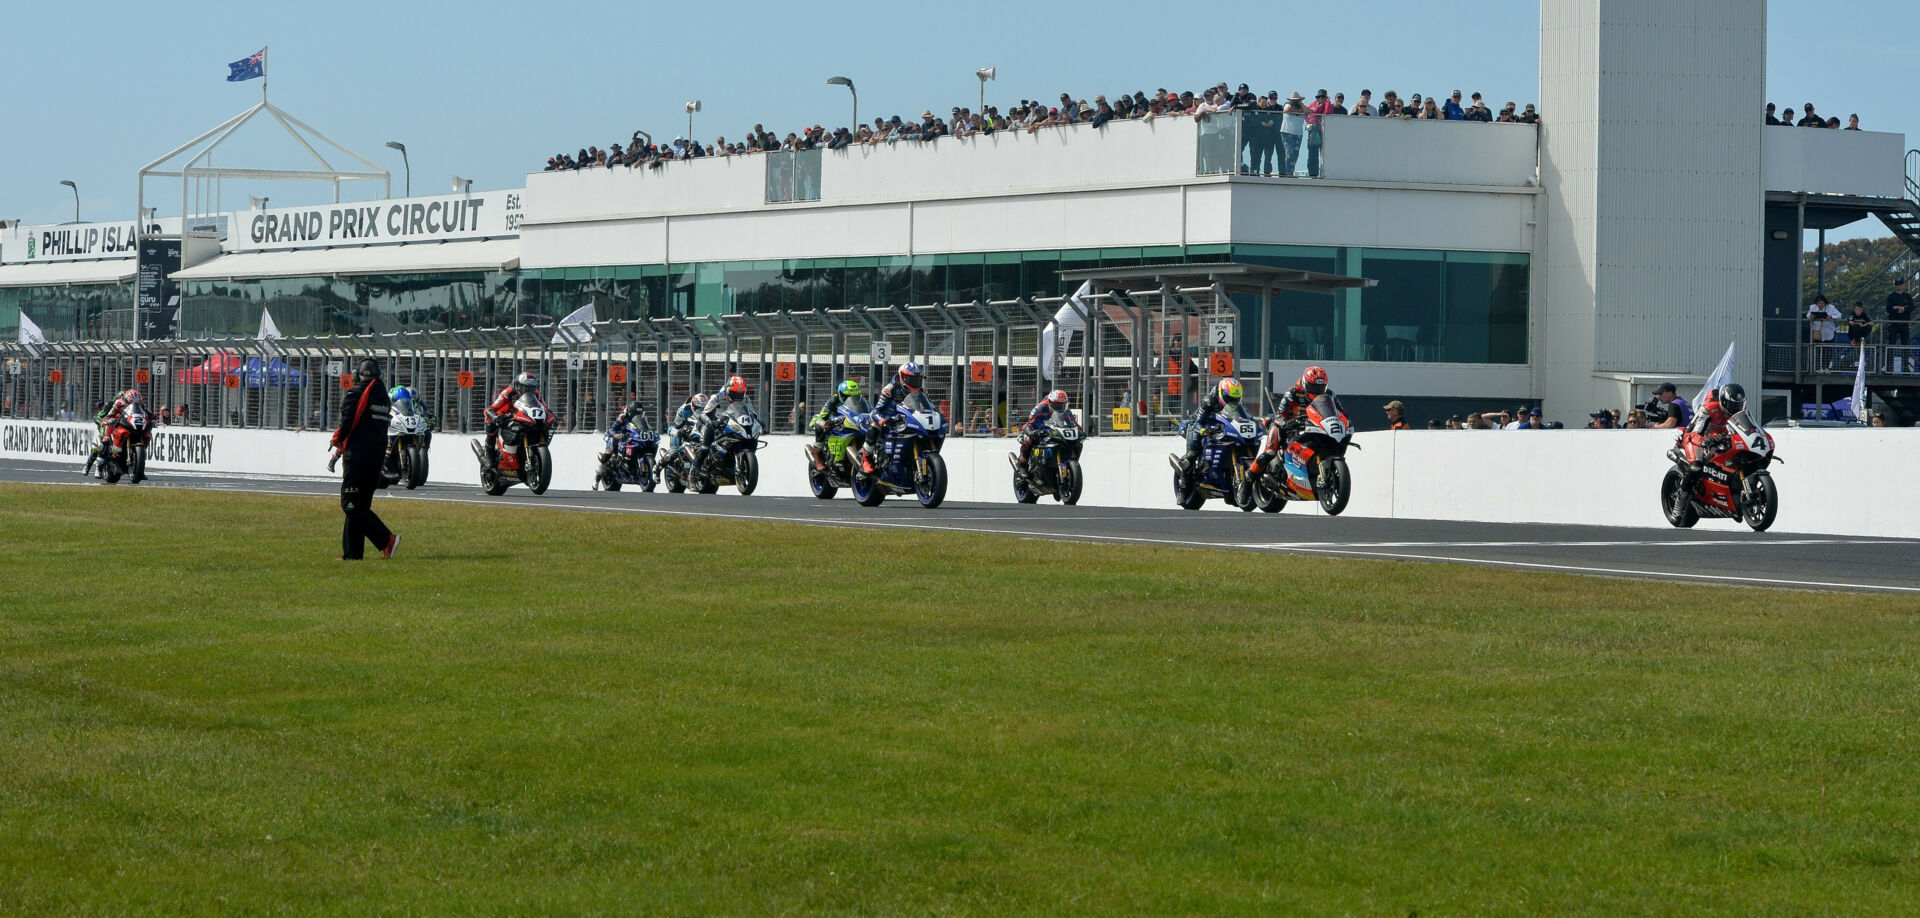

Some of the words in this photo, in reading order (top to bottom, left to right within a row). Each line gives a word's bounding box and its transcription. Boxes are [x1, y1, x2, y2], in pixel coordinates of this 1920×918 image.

[506, 193, 521, 210] Est.
[251, 210, 323, 243] GRAND
[329, 206, 381, 239] PRIX
[387, 198, 484, 236] CIRCUIT
[42, 228, 99, 255] PHILLIP
[1217, 331, 1226, 344] 2
[878, 348, 886, 359] 3
[572, 359, 579, 368] 4
[1217, 360, 1226, 373] 3
[333, 366, 338, 375] 5
[614, 371, 621, 381] 6
[782, 368, 789, 379] 5
[978, 368, 986, 379] 4
[462, 376, 468, 386] 7
[532, 409, 544, 417] 17
[405, 417, 417, 425] 13
[925, 415, 933, 425] 1
[1240, 424, 1254, 434] 65
[1330, 423, 1343, 434] 21
[3, 425, 29, 452] GRAND
[30, 426, 54, 454] RIDGE
[1751, 436, 1767, 451] 4
[146, 432, 166, 462] DGE
[168, 433, 214, 464] BREWERY
[1702, 465, 1728, 481] DUCATI
